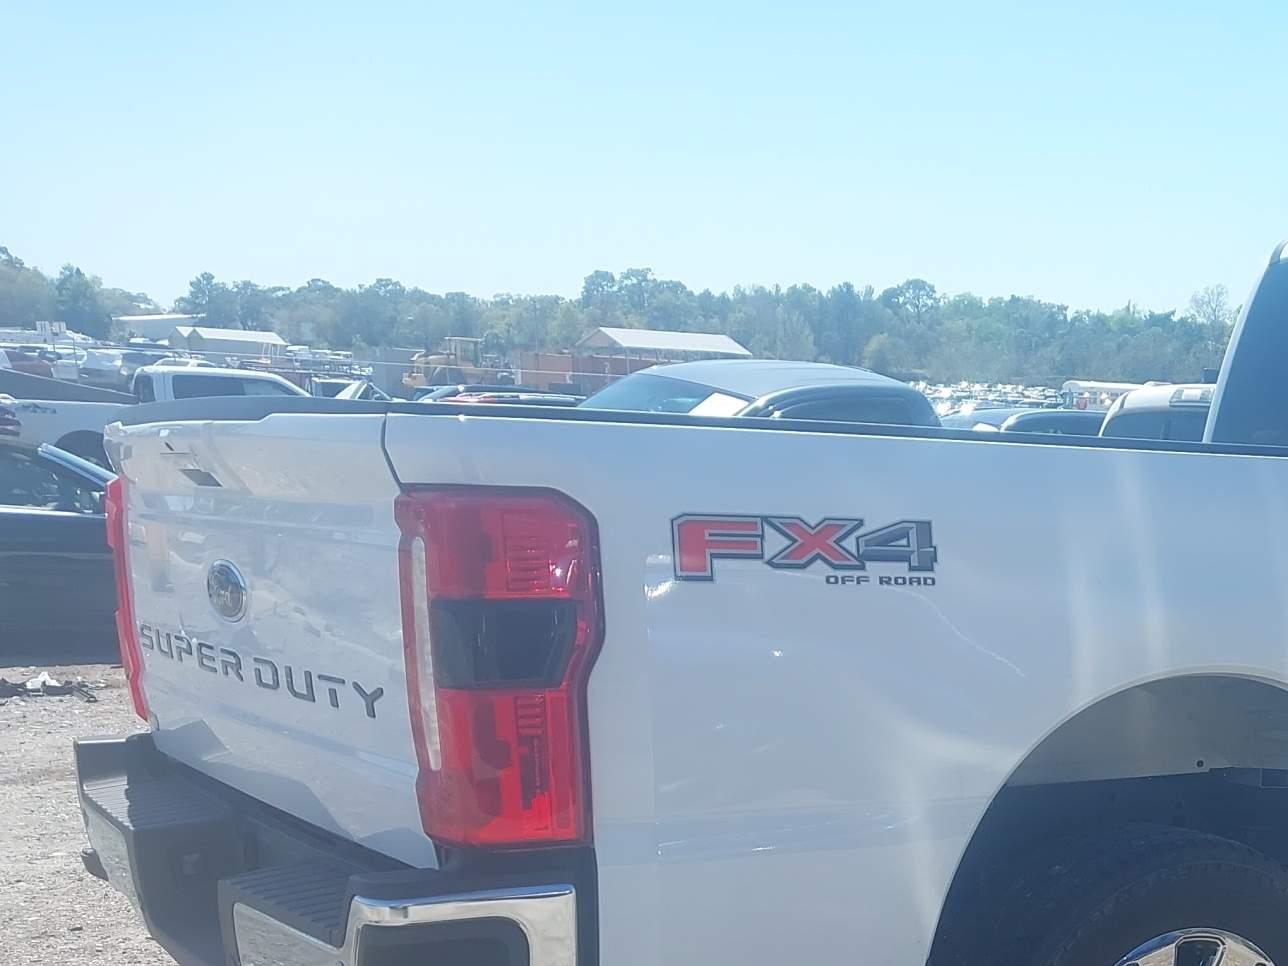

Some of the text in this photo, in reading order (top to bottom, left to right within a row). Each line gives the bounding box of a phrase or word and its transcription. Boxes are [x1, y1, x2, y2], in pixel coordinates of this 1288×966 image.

[670, 512, 938, 582] FX4
[825, 574, 936, 587] OFF ROAD
[139, 623, 385, 720] SUPER DUTY
